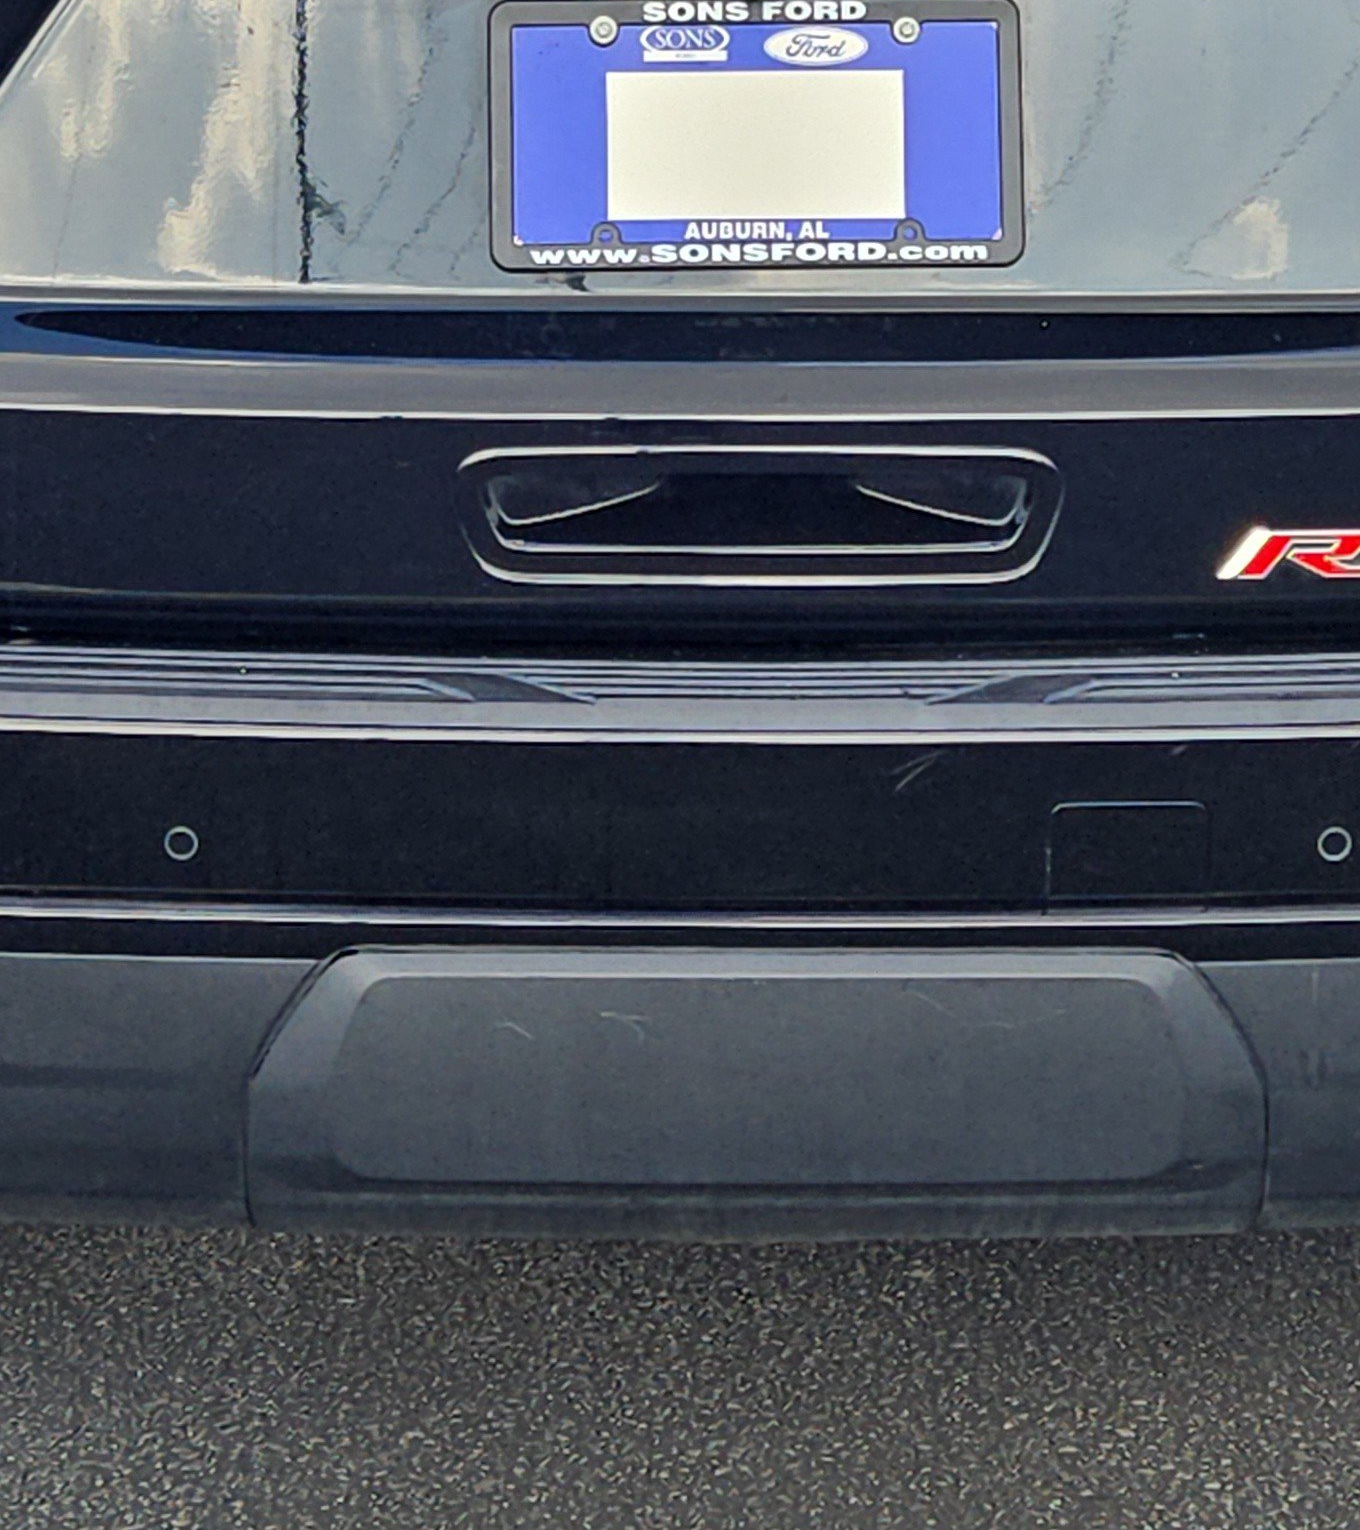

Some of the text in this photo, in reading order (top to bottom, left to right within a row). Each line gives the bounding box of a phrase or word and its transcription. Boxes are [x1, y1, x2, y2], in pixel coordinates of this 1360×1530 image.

[643, 0, 867, 22] SONS FORD
[654, 28, 717, 49] SONS
[785, 33, 847, 58] Ford
[684, 221, 830, 241] AUBURN, AL
[530, 242, 989, 264] www.SONSFORD.com
